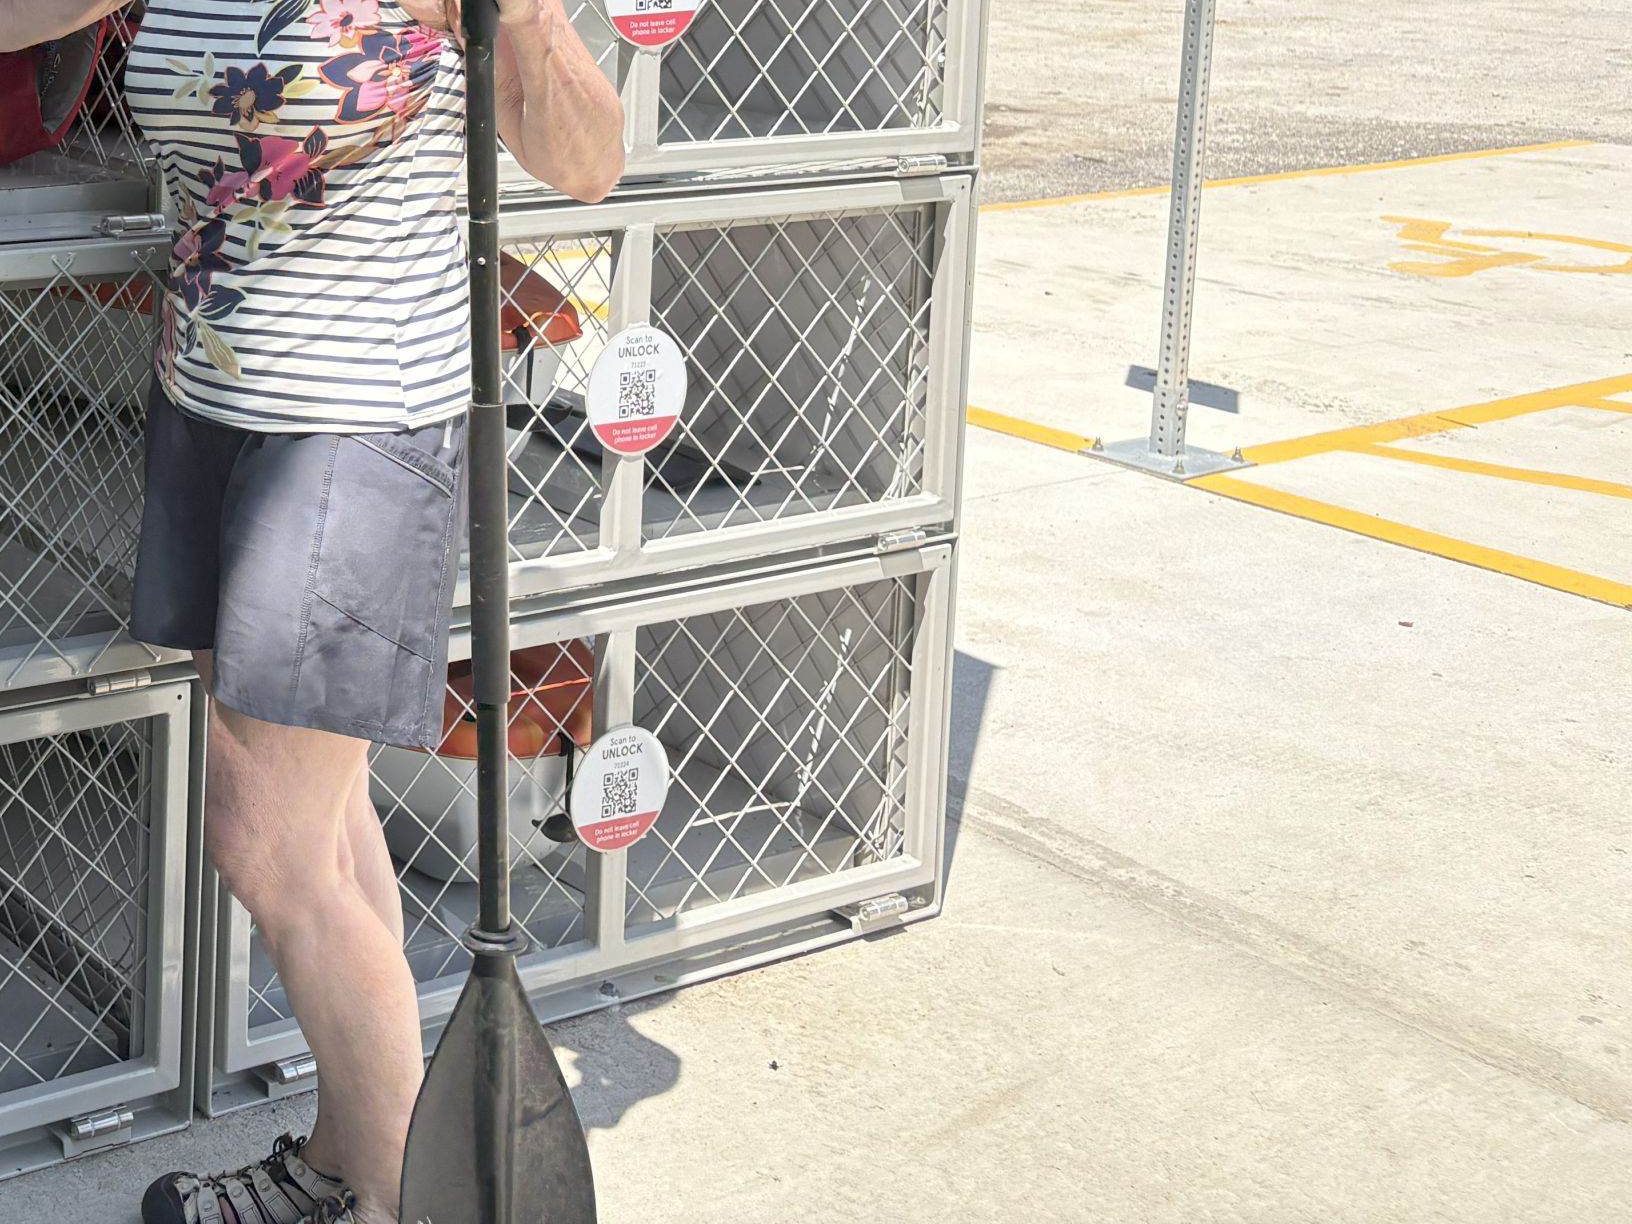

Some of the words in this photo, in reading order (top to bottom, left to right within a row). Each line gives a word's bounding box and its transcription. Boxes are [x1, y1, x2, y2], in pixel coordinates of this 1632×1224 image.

[632, 28, 650, 36] phone
[626, 336, 643, 344] Scan
[645, 335, 652, 343] to
[618, 344, 660, 358] UNLOCK
[613, 428, 620, 436] Do
[632, 426, 646, 434] leave
[647, 424, 657, 432] cell
[614, 435, 632, 444] phone
[639, 432, 656, 440] locker
[610, 737, 627, 746] Scan
[629, 736, 636, 744] to
[602, 743, 643, 759] UNLOCK
[595, 828, 602, 836] Do
[604, 826, 613, 834] not
[614, 824, 628, 832] leave
[630, 821, 639, 829] cell
[596, 834, 614, 844] phone
[622, 830, 638, 838] locker
